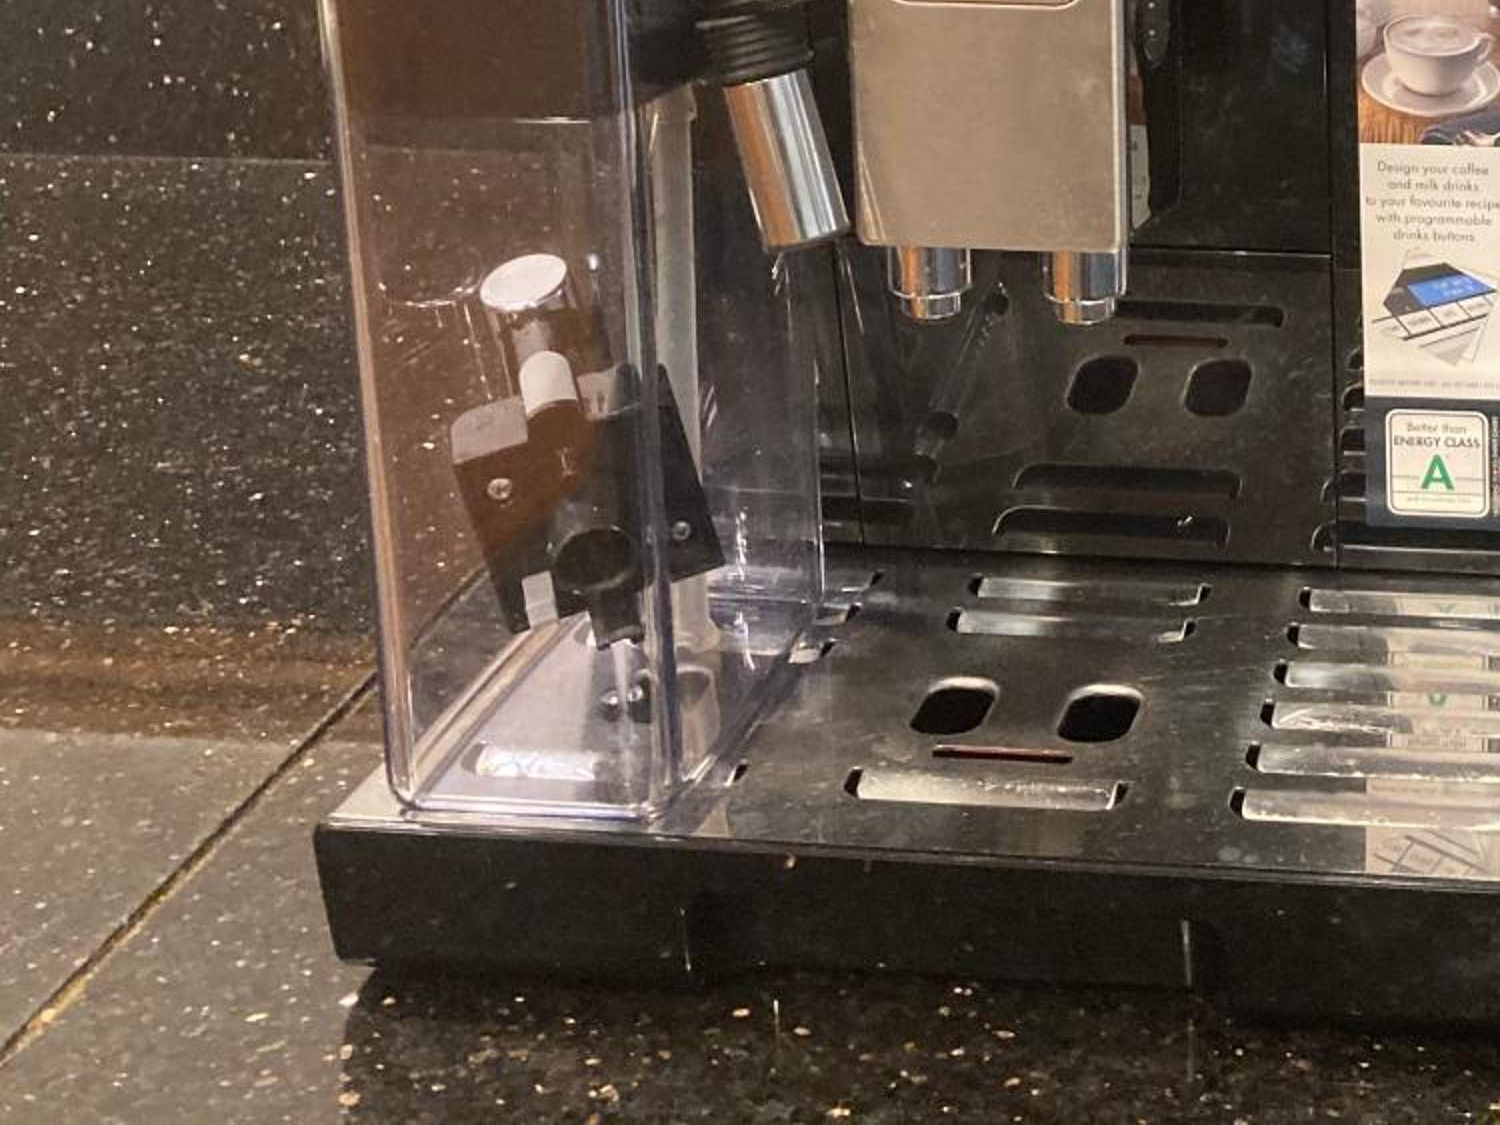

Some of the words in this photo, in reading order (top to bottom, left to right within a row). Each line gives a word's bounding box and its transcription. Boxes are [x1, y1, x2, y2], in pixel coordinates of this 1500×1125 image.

[1377, 160, 1420, 177] Design
[1422, 164, 1448, 176] your
[1451, 163, 1489, 175] coffee
[1387, 178, 1412, 190] and
[1415, 179, 1439, 191] milk
[1443, 179, 1479, 192] drinks
[1365, 195, 1377, 206] to
[1379, 196, 1406, 209] your
[1375, 211, 1401, 223] with
[1393, 229, 1429, 241] drinks
[1393, 435, 1441, 447] ENERGY
[1444, 436, 1481, 449] CLASS
[1420, 453, 1456, 491] A
